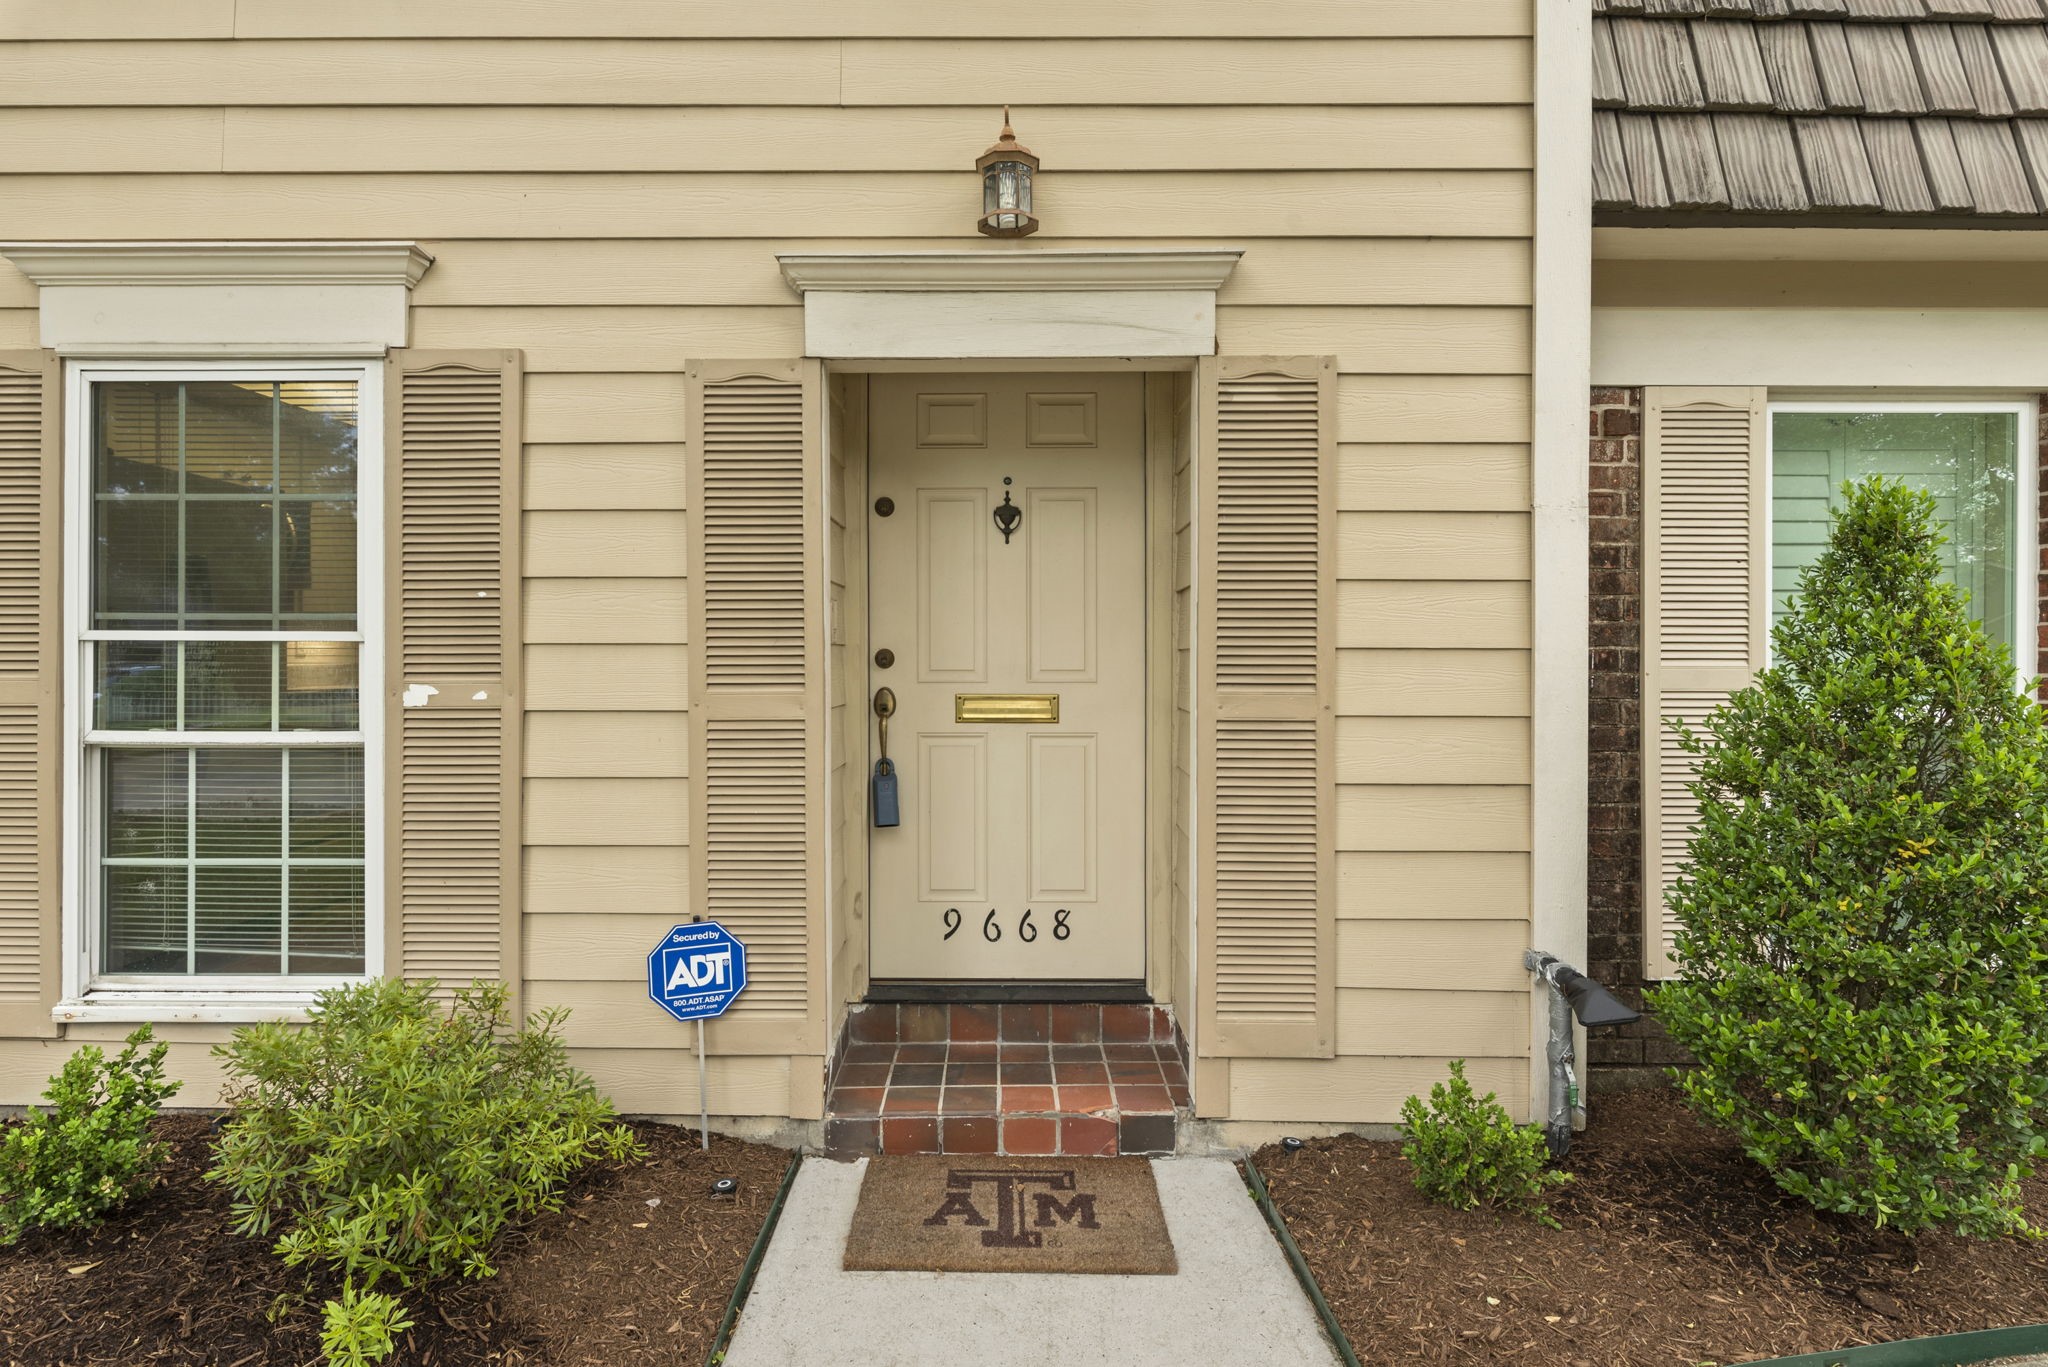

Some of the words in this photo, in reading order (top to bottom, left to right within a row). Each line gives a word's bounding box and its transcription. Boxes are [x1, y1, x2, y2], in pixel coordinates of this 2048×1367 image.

[943, 908, 1071, 942] 9668
[672, 931, 709, 942] Secured
[709, 931, 720, 940] by
[666, 952, 730, 990] ADT
[682, 1004, 718, 1012] www.ADT.com
